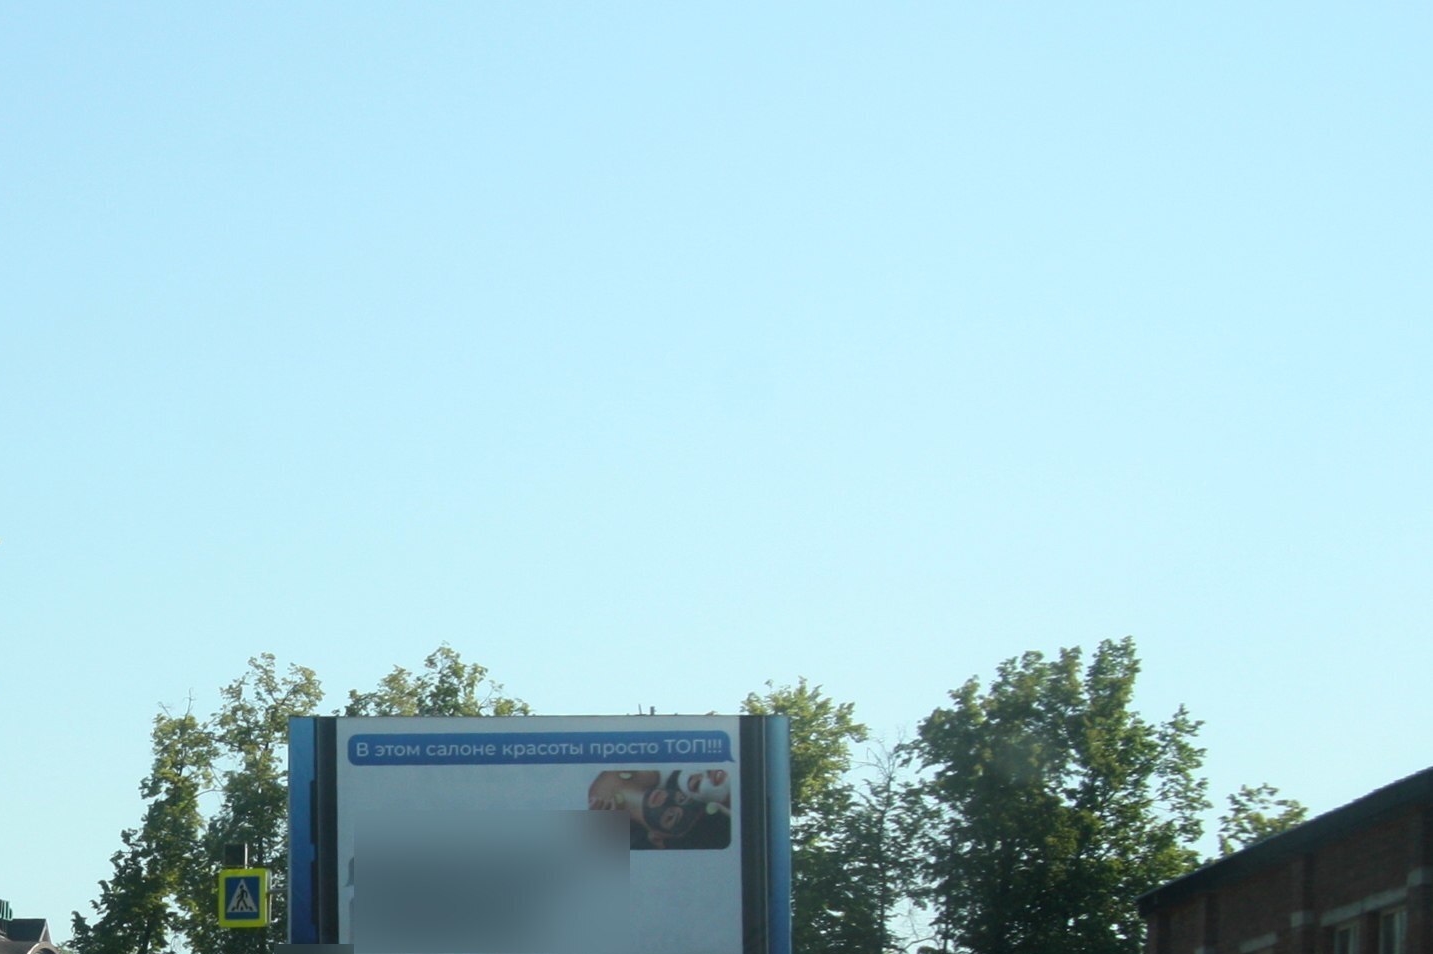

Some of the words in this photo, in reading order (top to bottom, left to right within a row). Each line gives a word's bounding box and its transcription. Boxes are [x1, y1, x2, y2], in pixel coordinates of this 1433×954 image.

[356, 742, 369, 757] В
[375, 744, 420, 757] этом
[426, 743, 496, 757] салоне
[502, 743, 583, 759] красоты
[590, 742, 658, 758] просто
[664, 738, 722, 753] ТОП!!!
